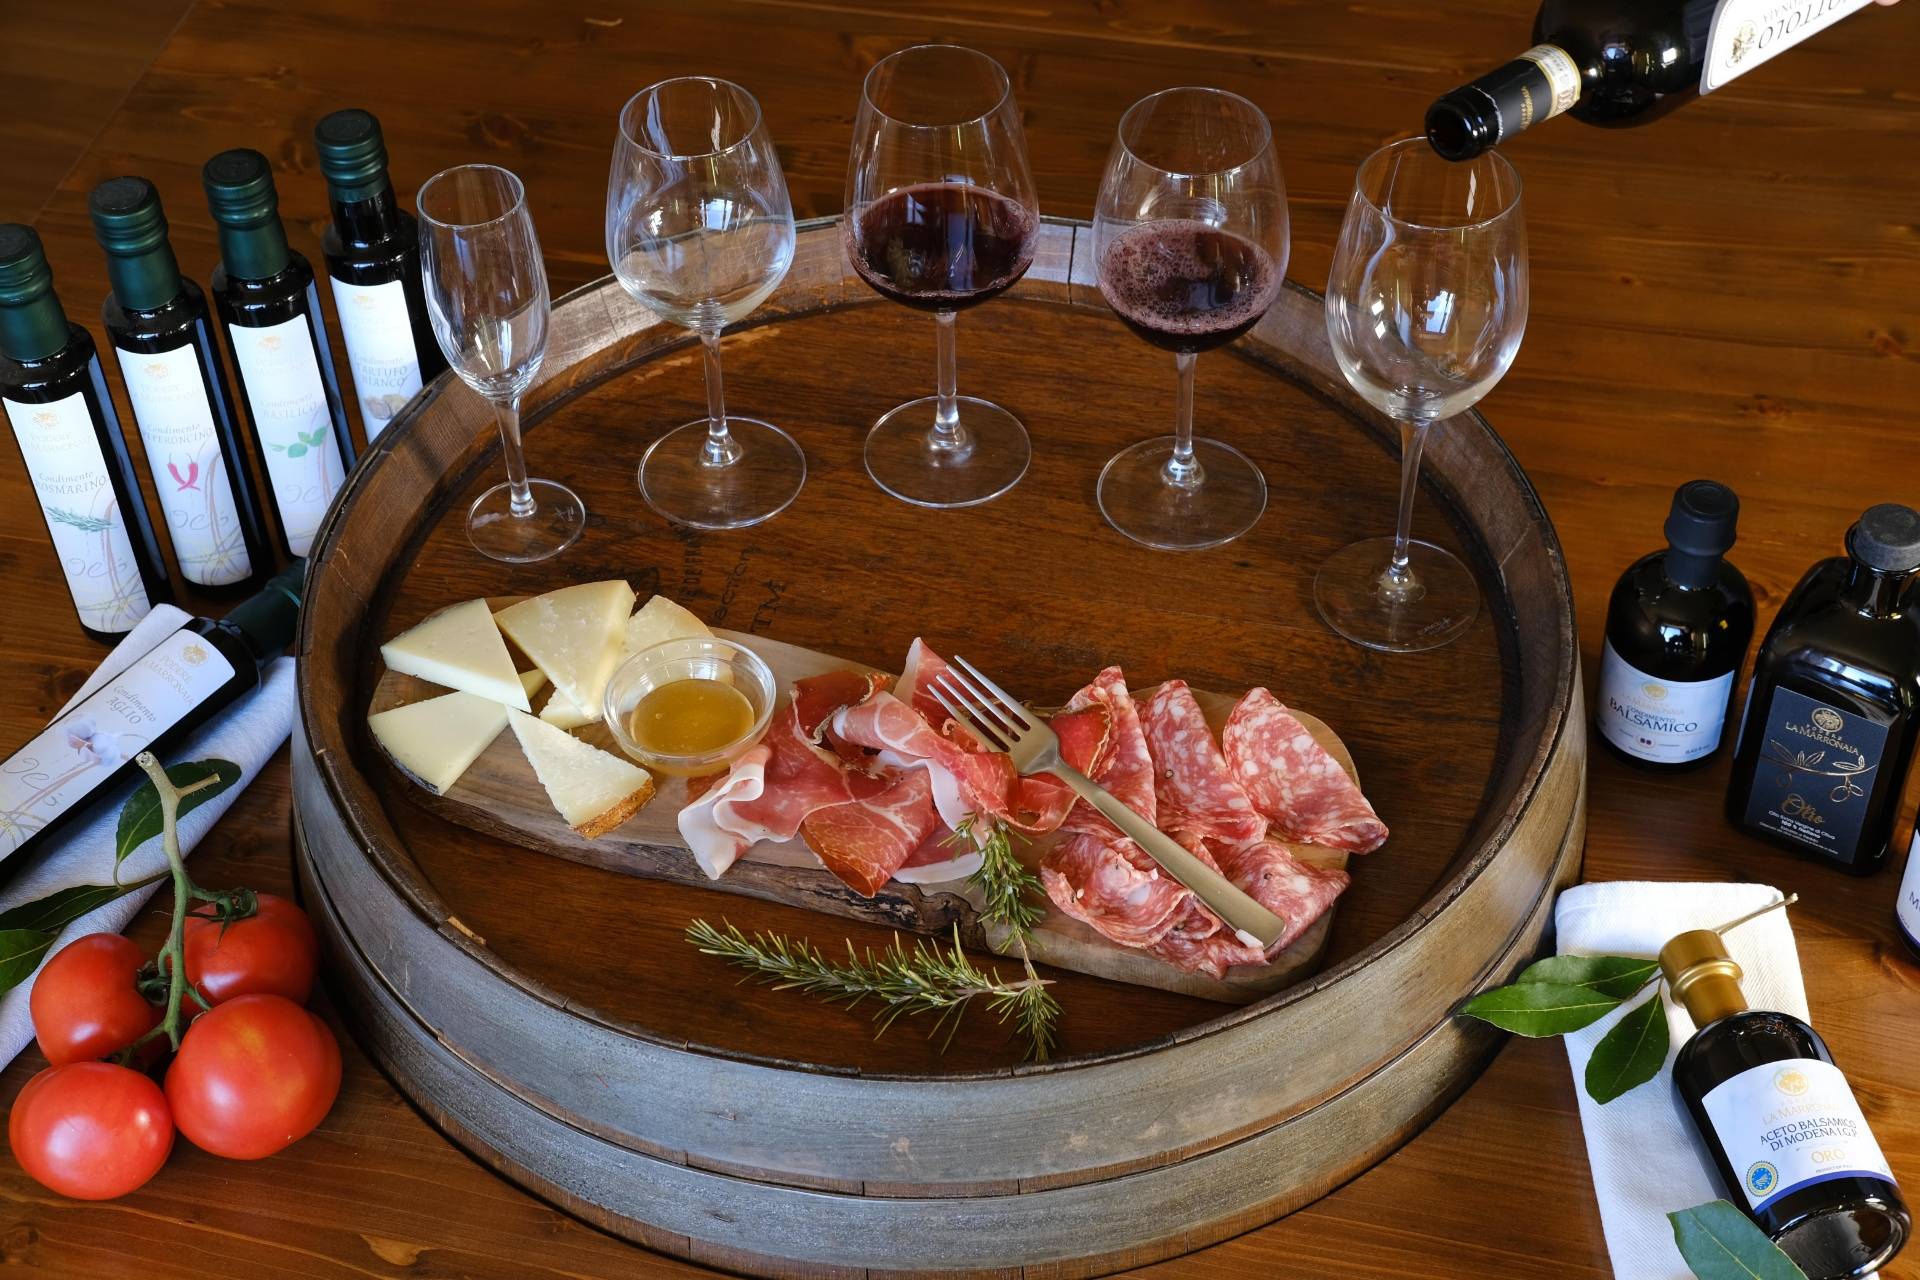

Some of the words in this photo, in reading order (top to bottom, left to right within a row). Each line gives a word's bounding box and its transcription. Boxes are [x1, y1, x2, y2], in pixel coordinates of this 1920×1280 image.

[106, 696, 142, 724] AGLIO
[1609, 696, 1699, 733] BALSAMICO
[1785, 721, 1799, 733] LA
[1800, 725, 1860, 756] MARRONAIA
[1760, 1124, 1797, 1146] ACETO
[1800, 1117, 1857, 1131] BALSAMICO
[1770, 1141, 1784, 1152] DI
[1784, 1127, 1837, 1147] MODENA
[1810, 1148, 1846, 1164] ORO
